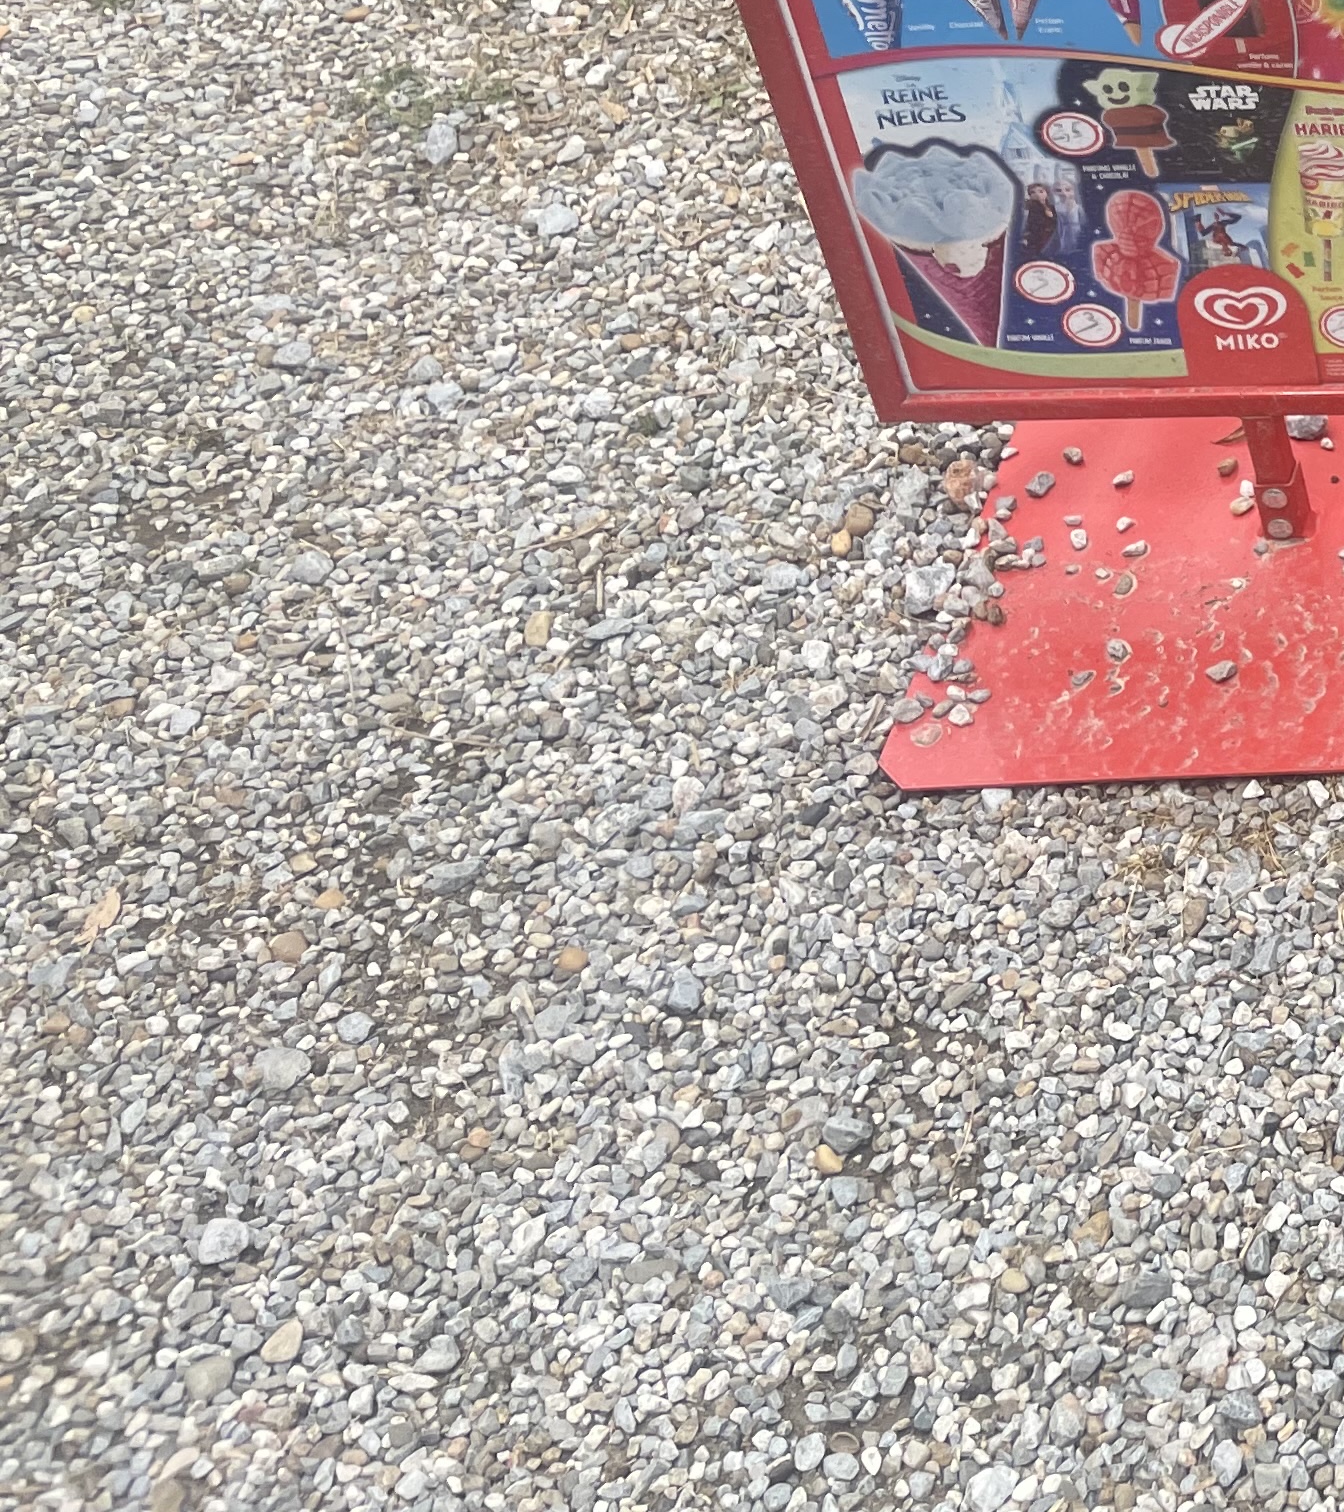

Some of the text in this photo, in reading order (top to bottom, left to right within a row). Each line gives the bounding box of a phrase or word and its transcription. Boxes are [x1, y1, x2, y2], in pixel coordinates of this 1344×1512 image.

[881, 84, 948, 104] REINE
[1195, 85, 1260, 98] STAR
[1188, 93, 1260, 111] WARS
[875, 104, 966, 129] NEIGES
[1215, 333, 1280, 351] MIKO
